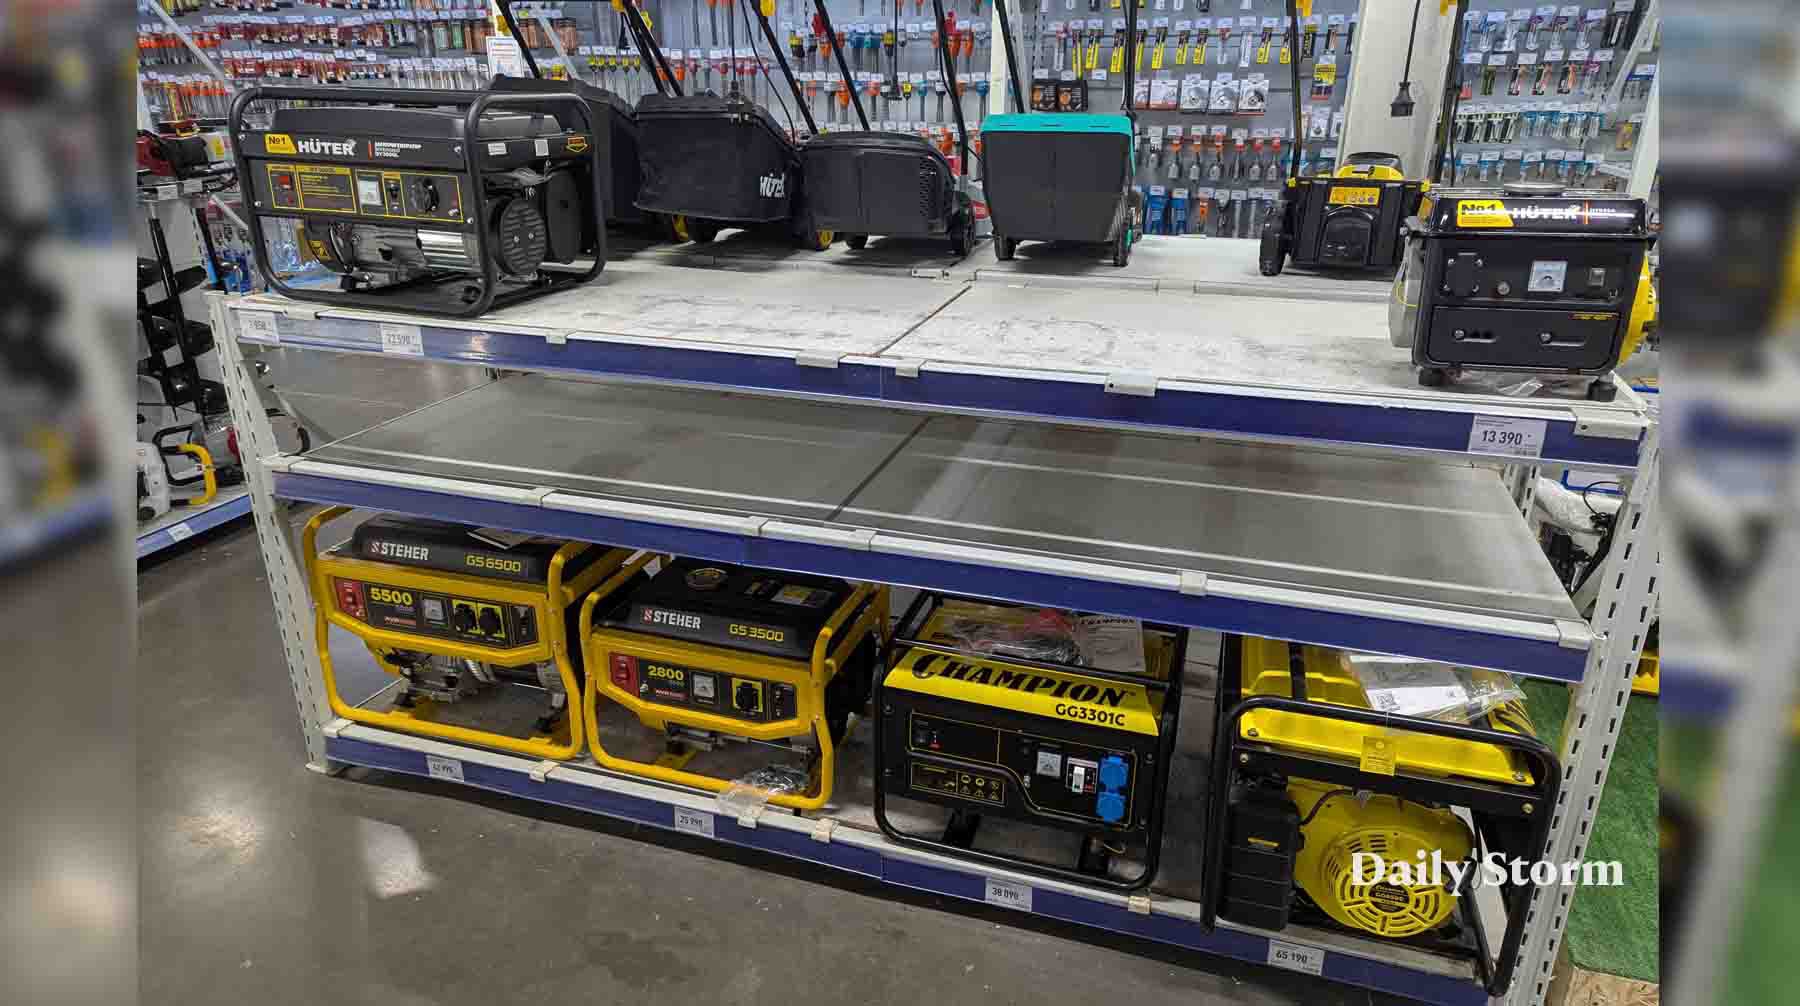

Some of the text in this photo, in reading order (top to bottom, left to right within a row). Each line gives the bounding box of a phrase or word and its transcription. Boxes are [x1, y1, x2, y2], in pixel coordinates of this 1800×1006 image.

[297, 137, 356, 156] HÜTER
[1481, 430, 1523, 446] 13 390
[382, 542, 429, 560] STEHER
[370, 587, 413, 606] 5500
[653, 610, 702, 629] STEHER
[647, 664, 684, 681] 2800
[911, 653, 1128, 708] CHAMPION
[1055, 703, 1127, 727] GG3301C
[1275, 950, 1308, 964] 65 190
